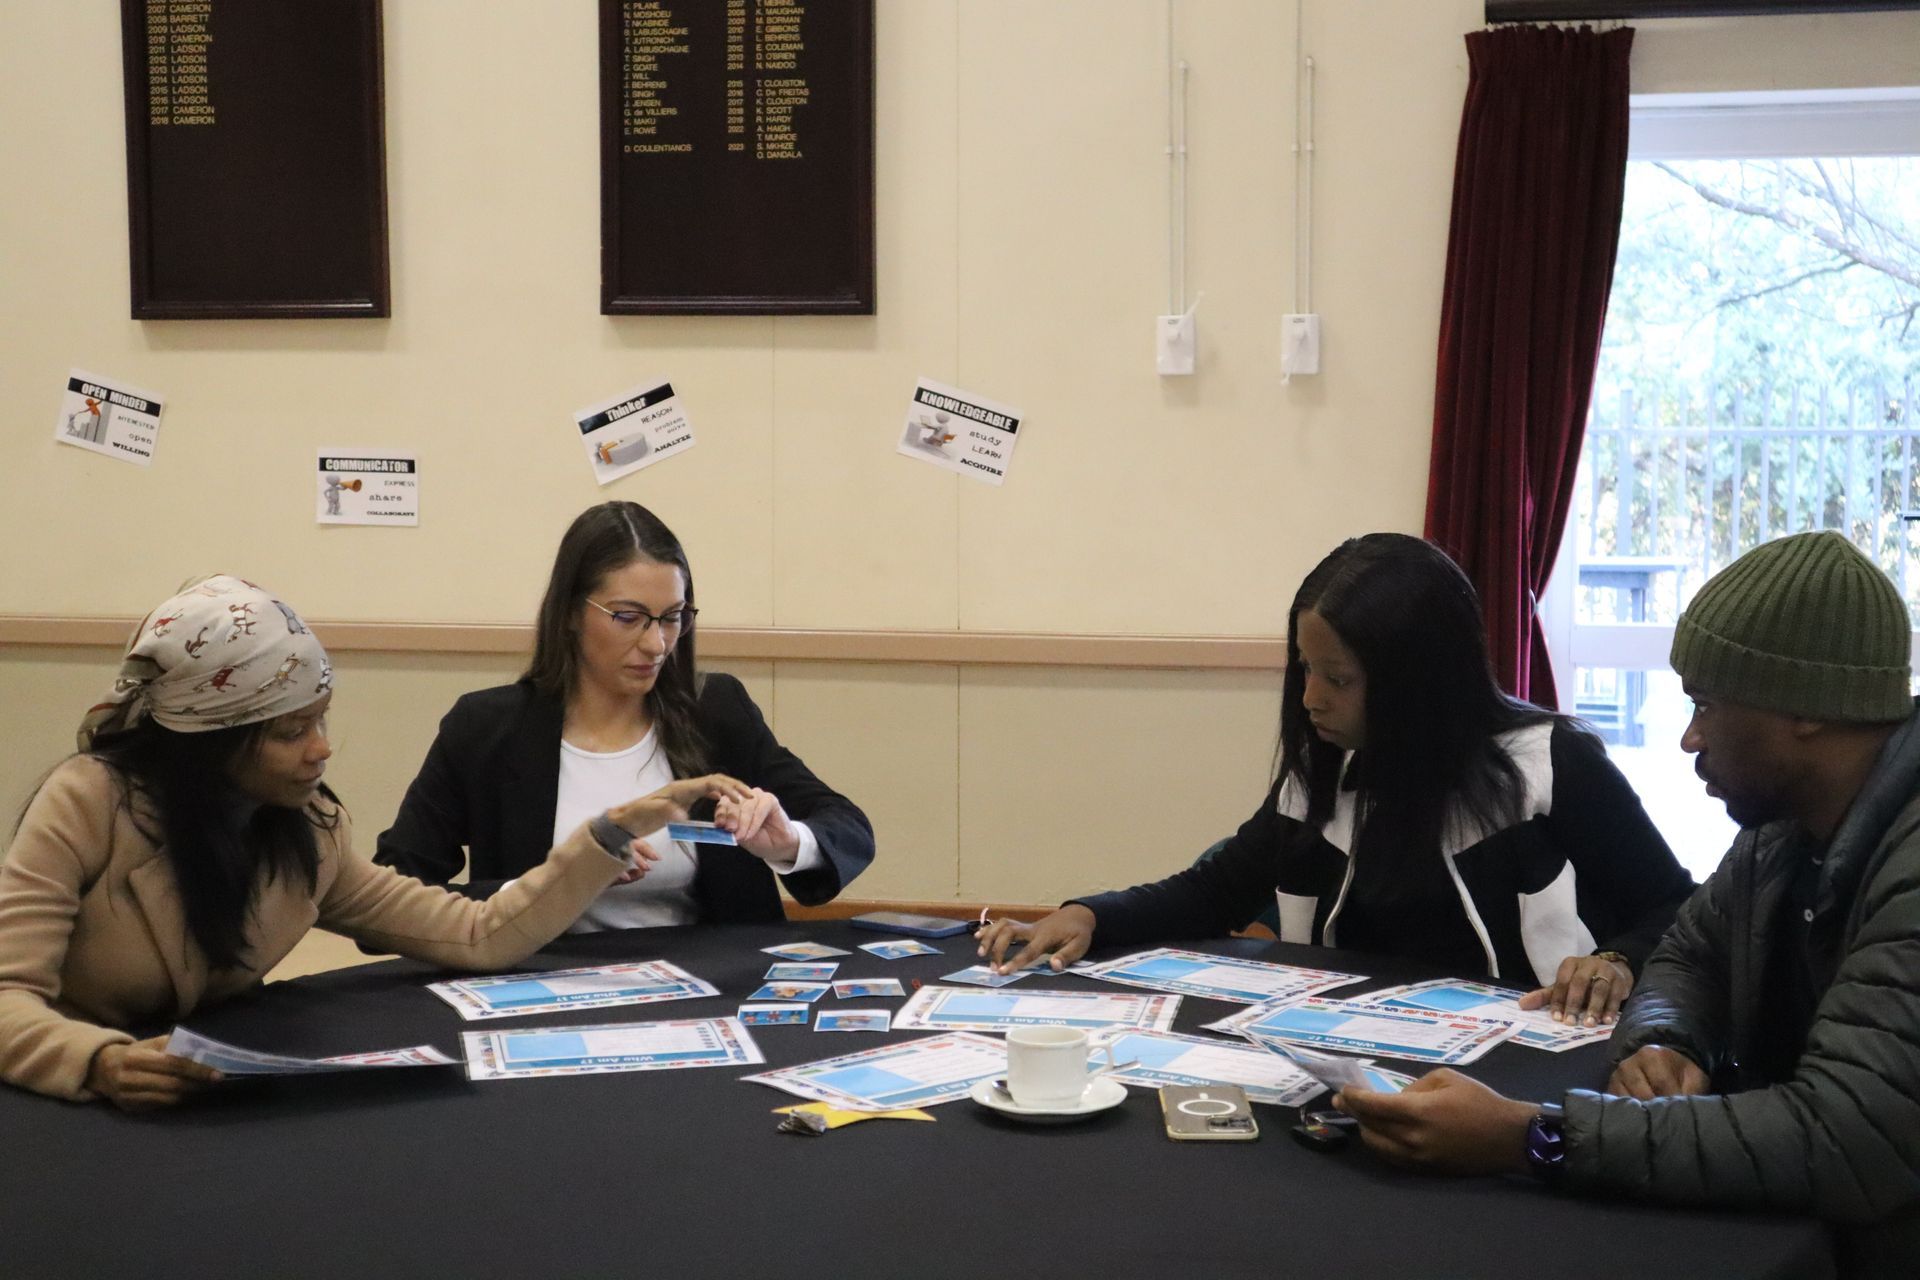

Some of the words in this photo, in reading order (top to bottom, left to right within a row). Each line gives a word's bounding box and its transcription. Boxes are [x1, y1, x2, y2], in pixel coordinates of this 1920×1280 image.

[147, 5, 166, 13] 2007
[169, 4, 211, 12] CAMERON
[170, 14, 209, 22] BARRETT
[148, 26, 167, 34] 2009
[170, 25, 205, 33] LADSON
[633, 27, 688, 35] LABUSCHAGNE
[148, 36, 166, 44] 2010
[170, 35, 213, 43] CAMERON
[148, 46, 165, 54] 2011
[171, 45, 206, 53] LADSON
[634, 45, 689, 53] LABUSCHAGNE
[149, 56, 166, 64] 2012
[171, 55, 206, 63] LADSON
[149, 66, 167, 74] 2013
[150, 76, 167, 84] 2014
[172, 76, 207, 84] LADSON
[172, 86, 207, 94] LADSON
[779, 88, 809, 96] FREITAS
[172, 96, 208, 104] LADSON
[151, 106, 168, 114] 2017
[766, 106, 793, 114] SCOTT
[173, 116, 215, 124] CAMERON
[81, 383, 107, 400] OPEN
[109, 391, 147, 411] MINDED
[606, 397, 646, 421] Thinker
[920, 390, 1012, 430] KNOWLEDGEABLE
[641, 406, 673, 424] REASON
[129, 433, 152, 444] open
[969, 431, 1002, 446] study
[112, 442, 150, 457] WILLING
[972, 445, 1002, 459] LEARN
[325, 459, 408, 472] COMMUNICATOR
[960, 458, 1003, 476] ACQUIRE
[1348, 1040, 1376, 1048] Who
[1182, 1077, 1210, 1085] Who
